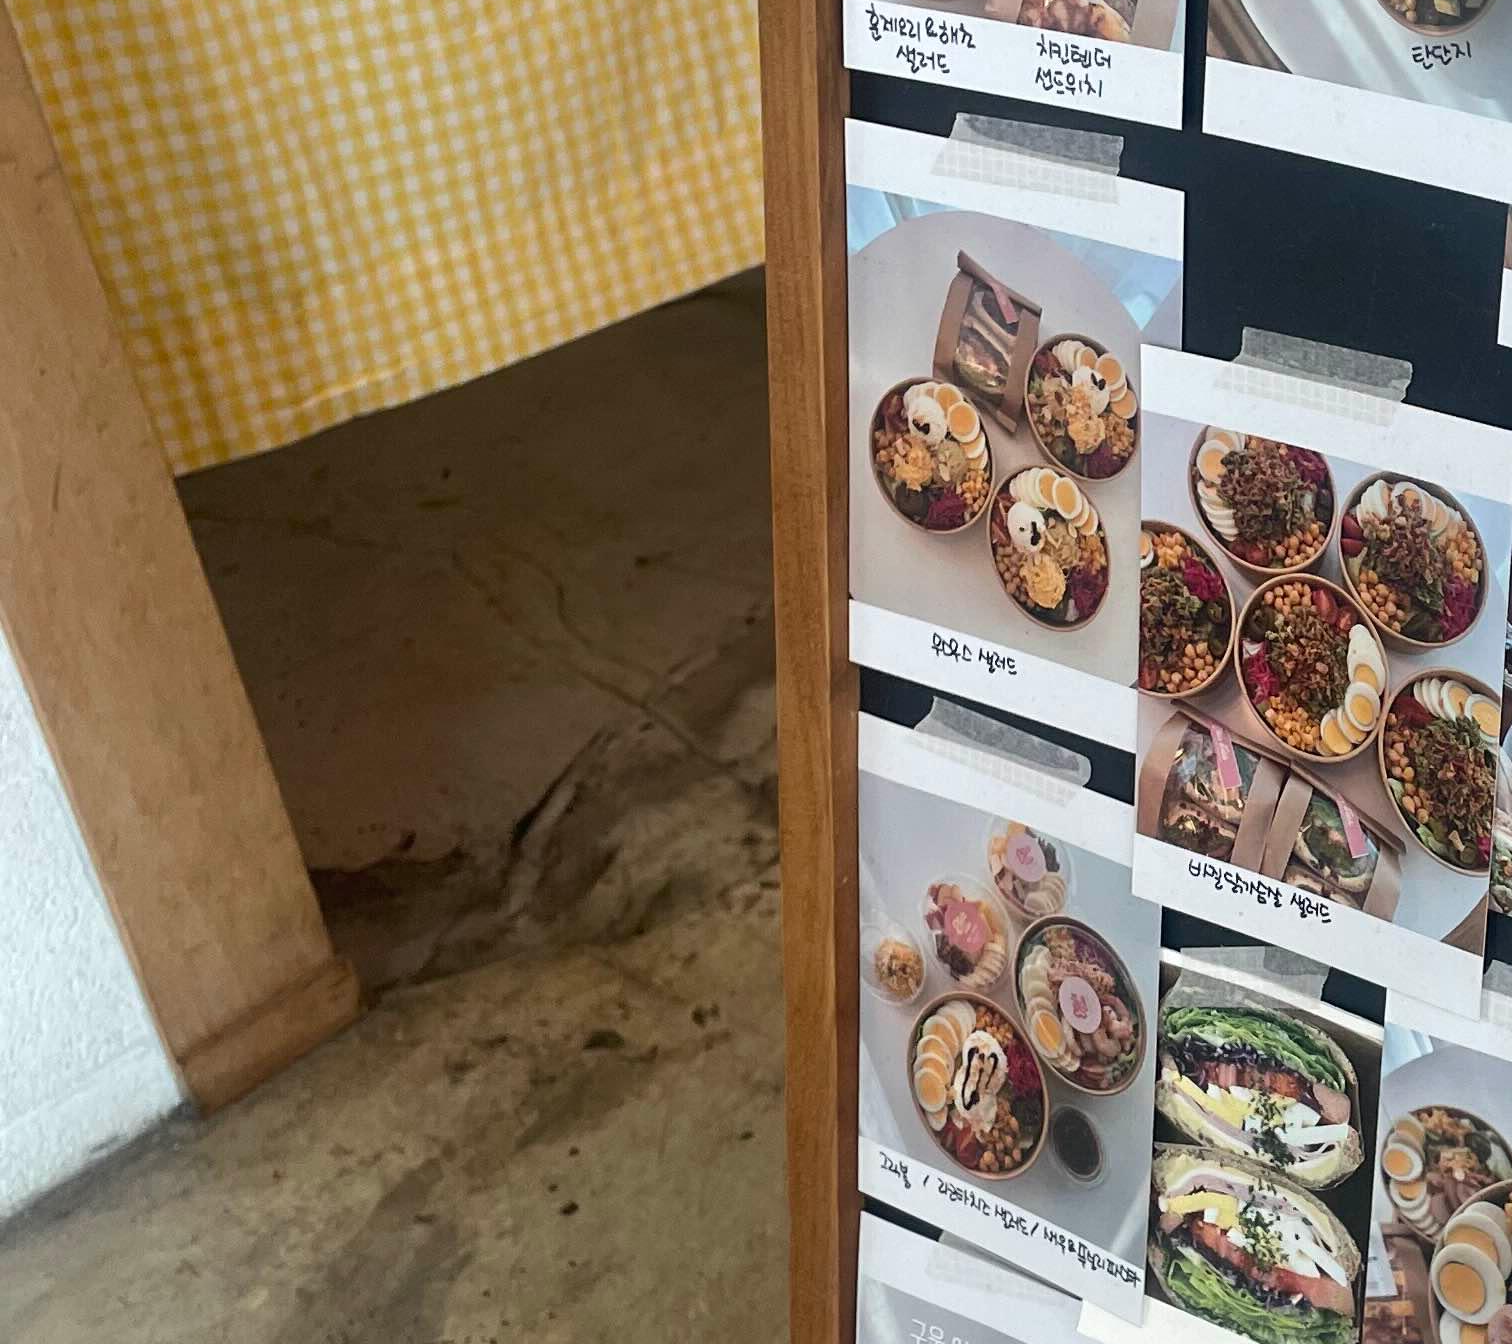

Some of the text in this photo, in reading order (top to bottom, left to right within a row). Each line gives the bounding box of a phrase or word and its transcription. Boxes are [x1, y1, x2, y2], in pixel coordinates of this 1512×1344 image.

[896, 45, 951, 74] 샐러드
[1036, 34, 1112, 69] 치킨텐더
[1411, 41, 1472, 70] 탄단지
[978, 647, 1018, 675] 샐러드
[1290, 892, 1332, 923] 샐러드
